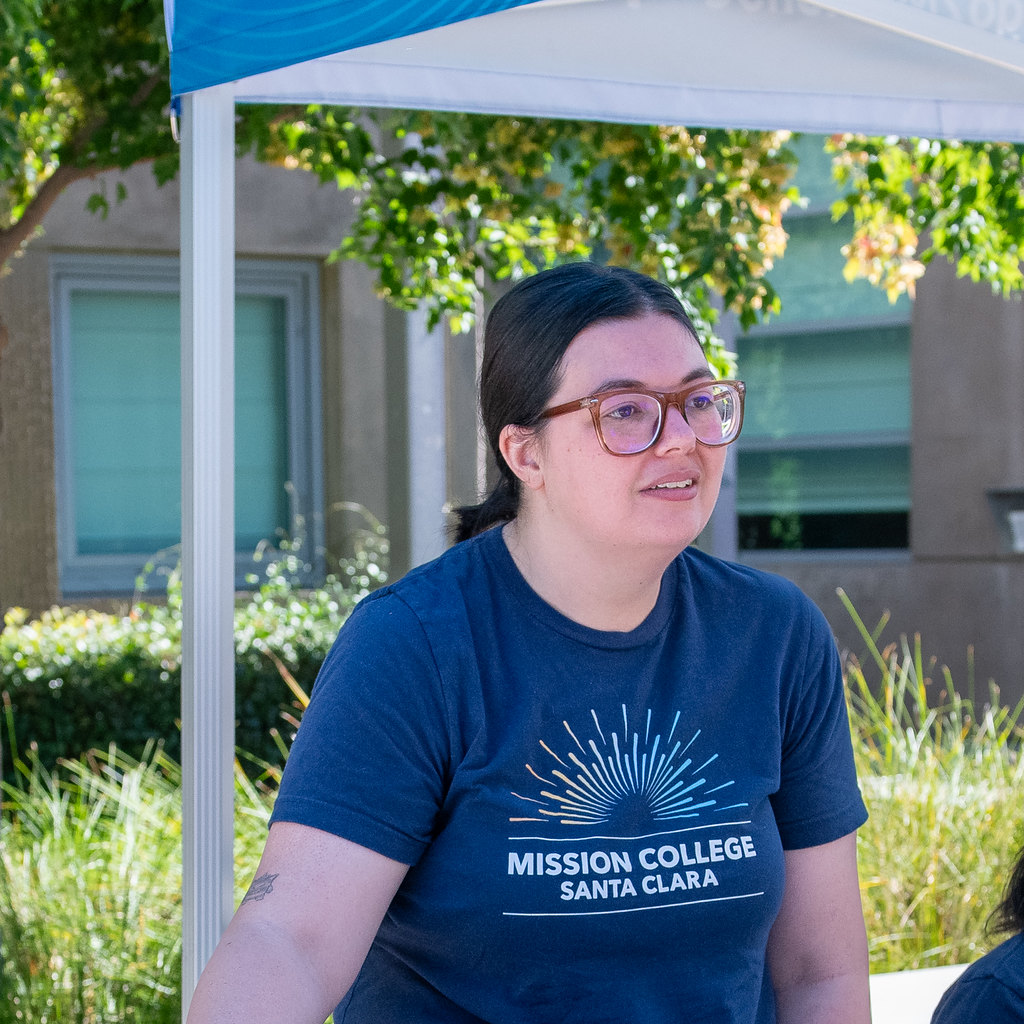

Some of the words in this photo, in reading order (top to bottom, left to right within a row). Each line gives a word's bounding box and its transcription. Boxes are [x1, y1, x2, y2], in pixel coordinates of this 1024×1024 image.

[507, 851, 632, 875] MISSION
[638, 836, 756, 871] COLLEGE
[560, 878, 637, 900] SANTA
[641, 868, 718, 894] CLARA
